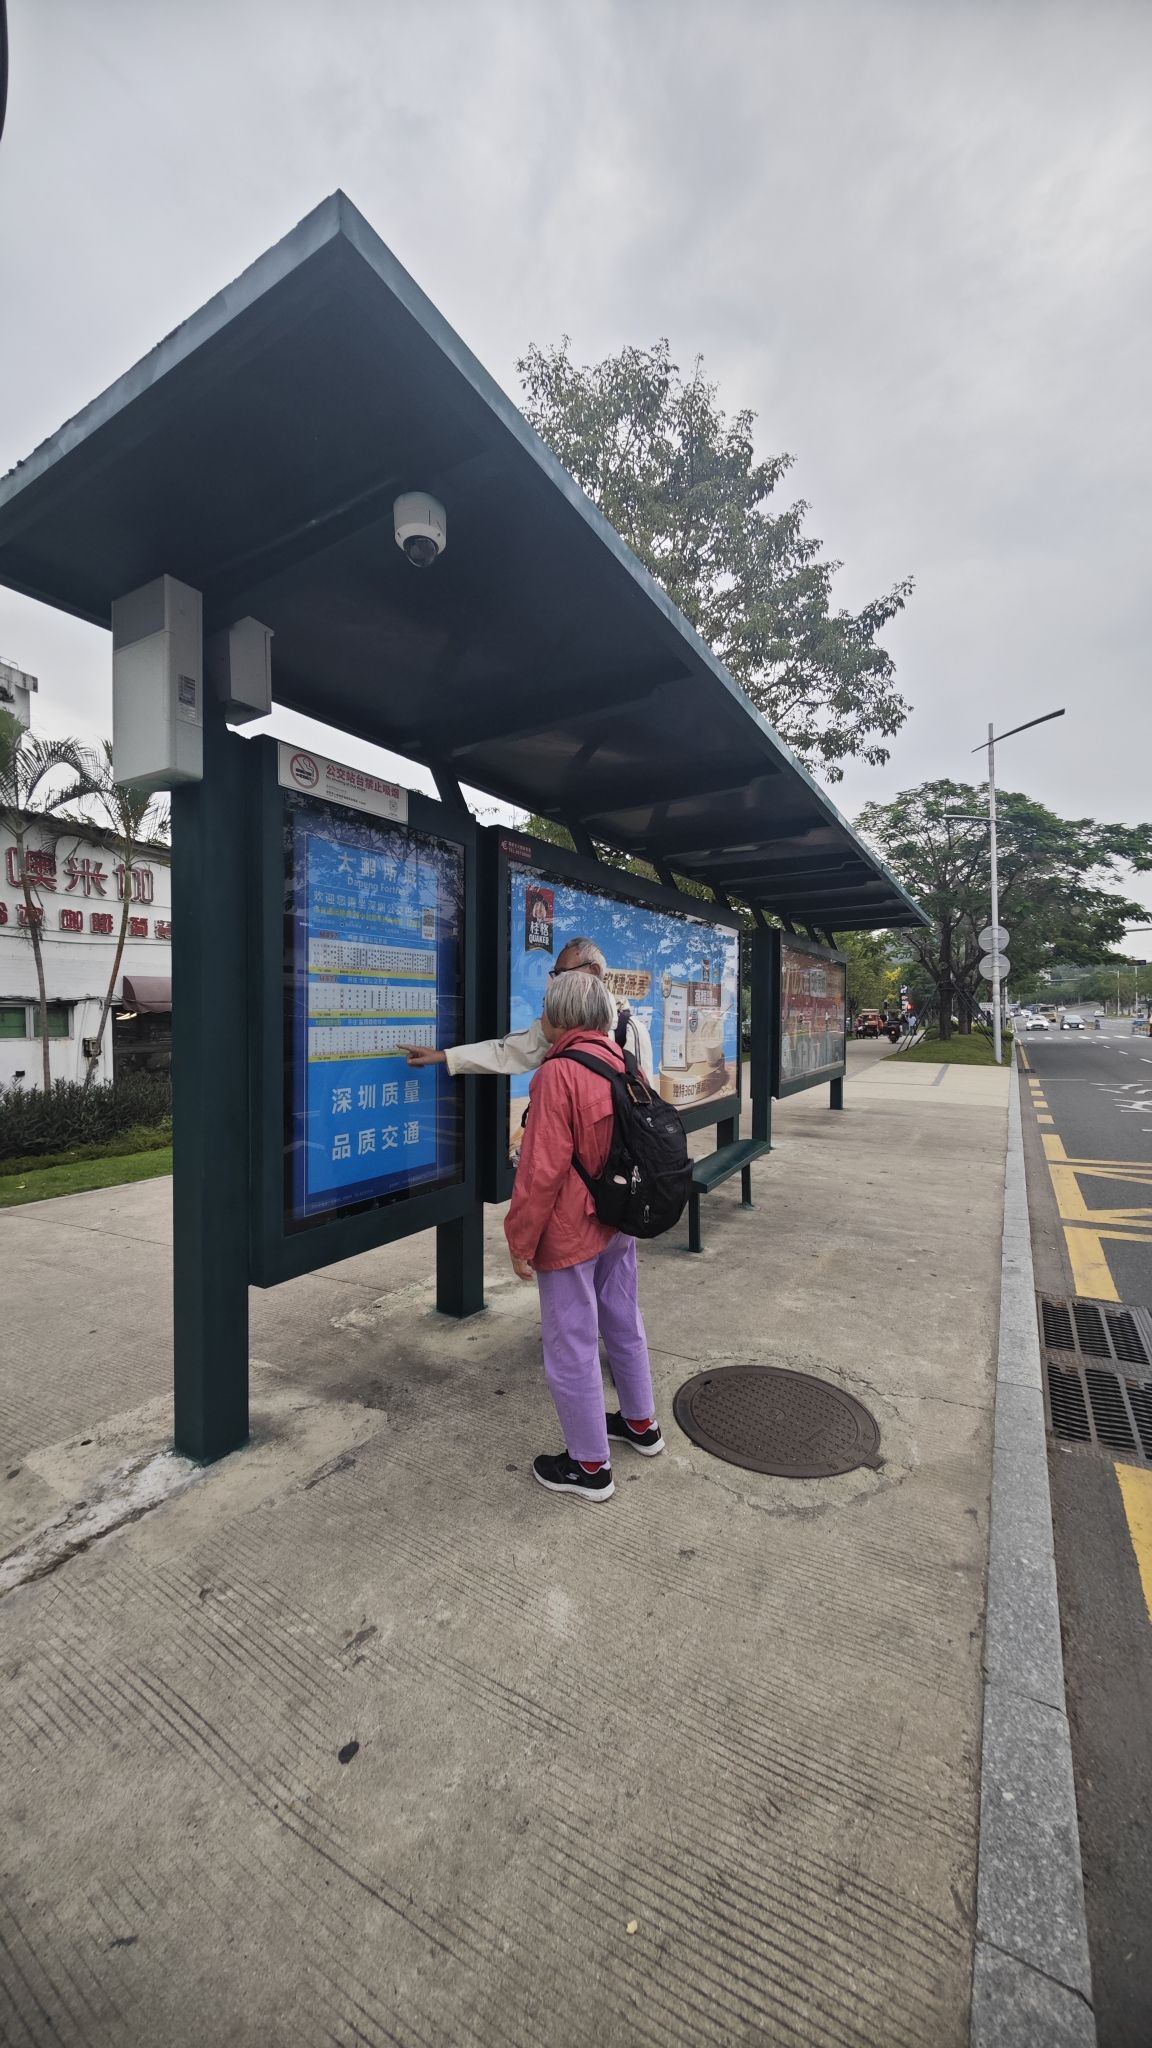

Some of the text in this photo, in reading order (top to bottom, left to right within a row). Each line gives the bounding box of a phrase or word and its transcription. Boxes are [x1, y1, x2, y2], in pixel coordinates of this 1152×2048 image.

[326, 764, 400, 800] 公交站台禁止吸烟
[528, 933, 550, 946] QUAKER
[530, 921, 549, 936] 桂格
[331, 1079, 420, 1115] 深圳质量
[331, 1120, 420, 1161] 品质交通
